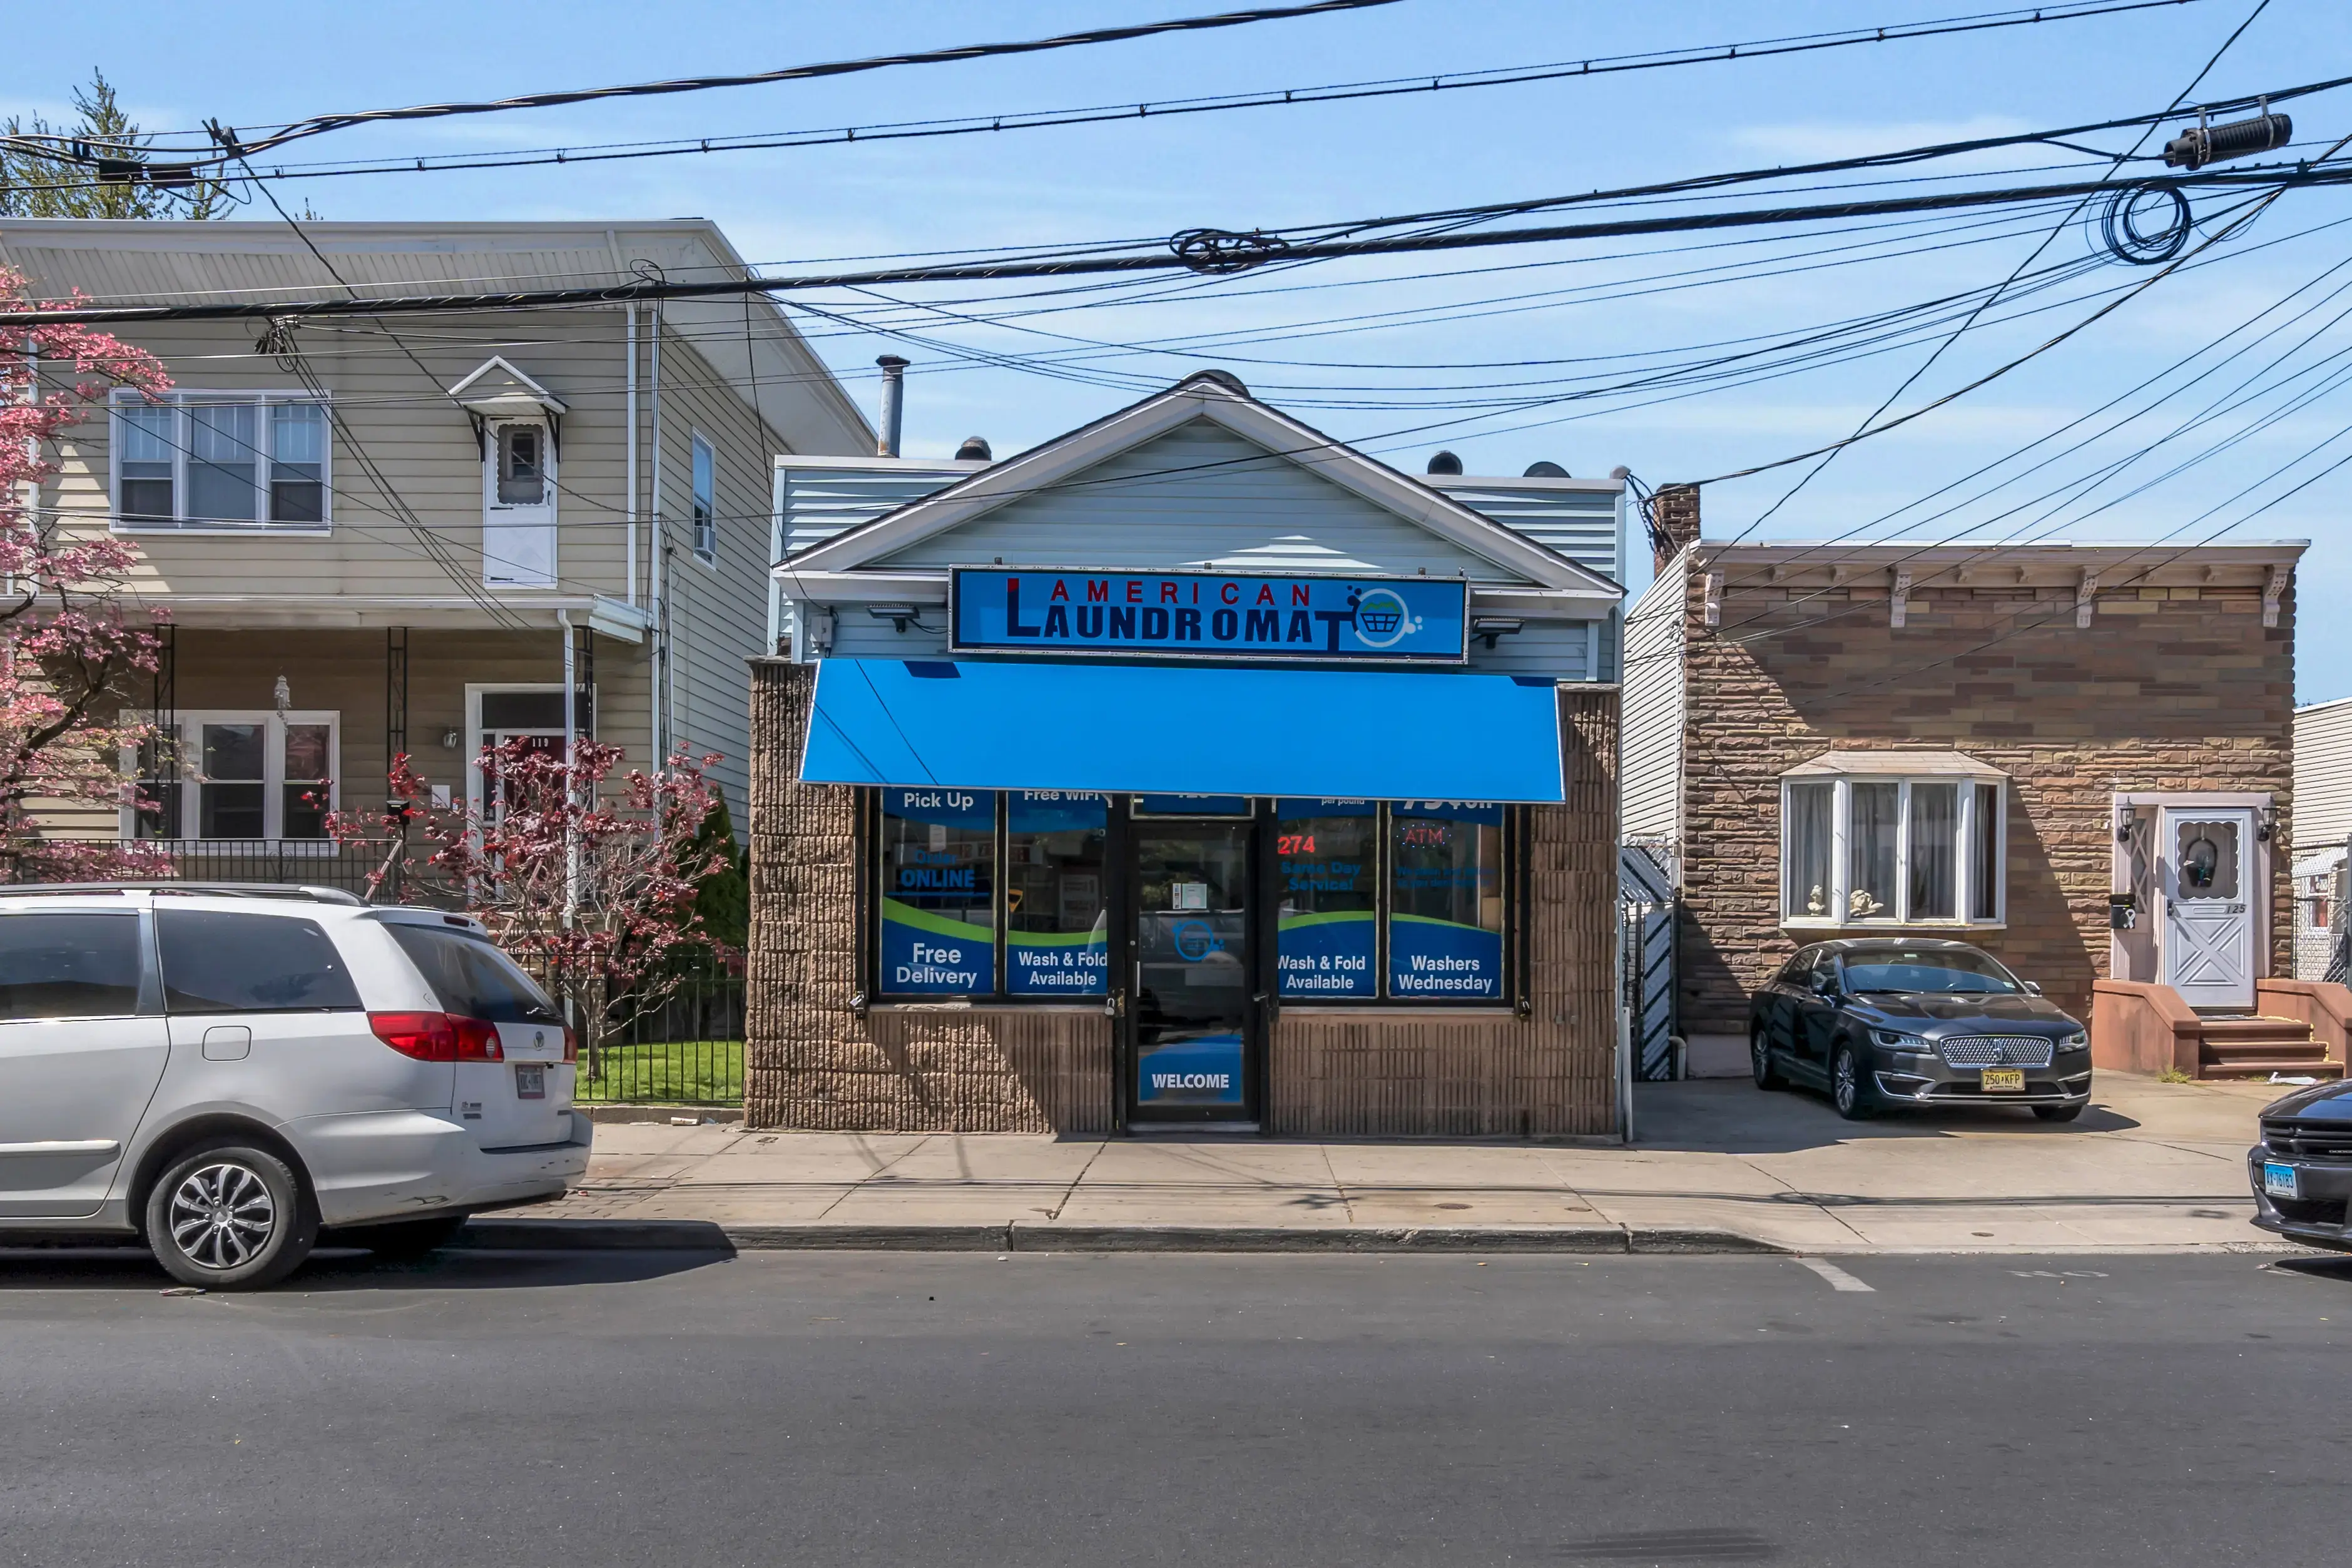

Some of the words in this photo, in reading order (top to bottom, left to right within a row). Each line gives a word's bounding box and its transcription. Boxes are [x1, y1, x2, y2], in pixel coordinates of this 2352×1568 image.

[1050, 579, 1310, 606] AMERICAN
[1007, 578, 1352, 651] LAUNDROMAT
[532, 738, 549, 747] 119
[904, 792, 941, 807] Pick
[947, 792, 974, 811] Up
[1024, 792, 1059, 800] Free
[1405, 828, 1443, 843] ATM
[1278, 835, 1316, 855] 274
[914, 849, 957, 865] Order
[1281, 861, 1326, 875] Same
[1330, 862, 1361, 878] Day
[900, 869, 975, 888] ONLINE
[1288, 876, 1355, 891] Service!
[2227, 905, 2246, 914] 125
[913, 943, 961, 964] Free
[1019, 952, 1058, 966] Wash
[1062, 952, 1074, 966] &
[1078, 952, 1107, 967] Fold
[1278, 955, 1315, 970] Wash
[1320, 956, 1330, 970] &
[1335, 955, 1366, 970] Fold
[1411, 955, 1480, 970] Washers
[897, 967, 977, 988] Delivery
[1029, 970, 1097, 985] Available
[1286, 974, 1354, 989] Available
[1398, 974, 1492, 994] Wednesday
[1152, 1074, 1229, 1089] WELCOME
